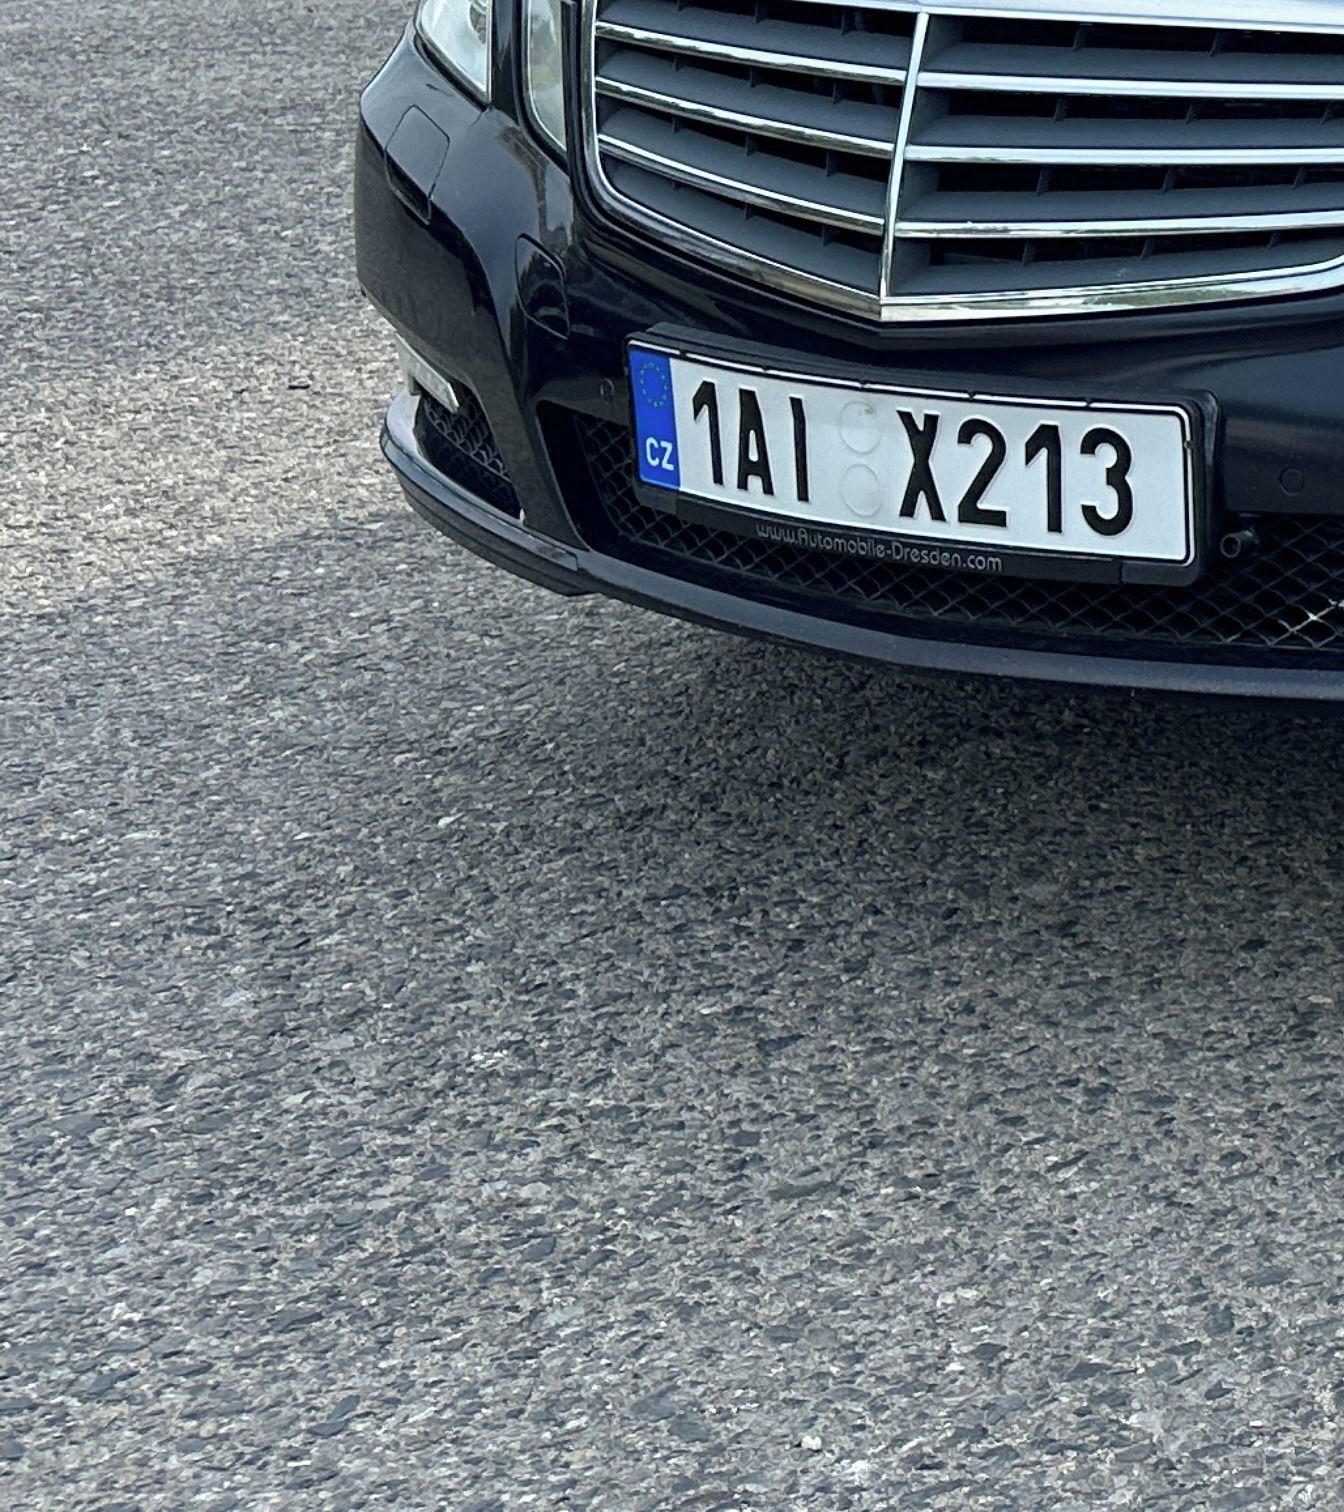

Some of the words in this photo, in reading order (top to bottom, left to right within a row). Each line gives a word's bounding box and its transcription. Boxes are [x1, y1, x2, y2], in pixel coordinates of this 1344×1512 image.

[645, 437, 675, 471] CZ
[692, 380, 810, 503] 1AI
[896, 409, 1134, 537] X213
[756, 524, 1002, 572] www.Automobile-Dresden.com
